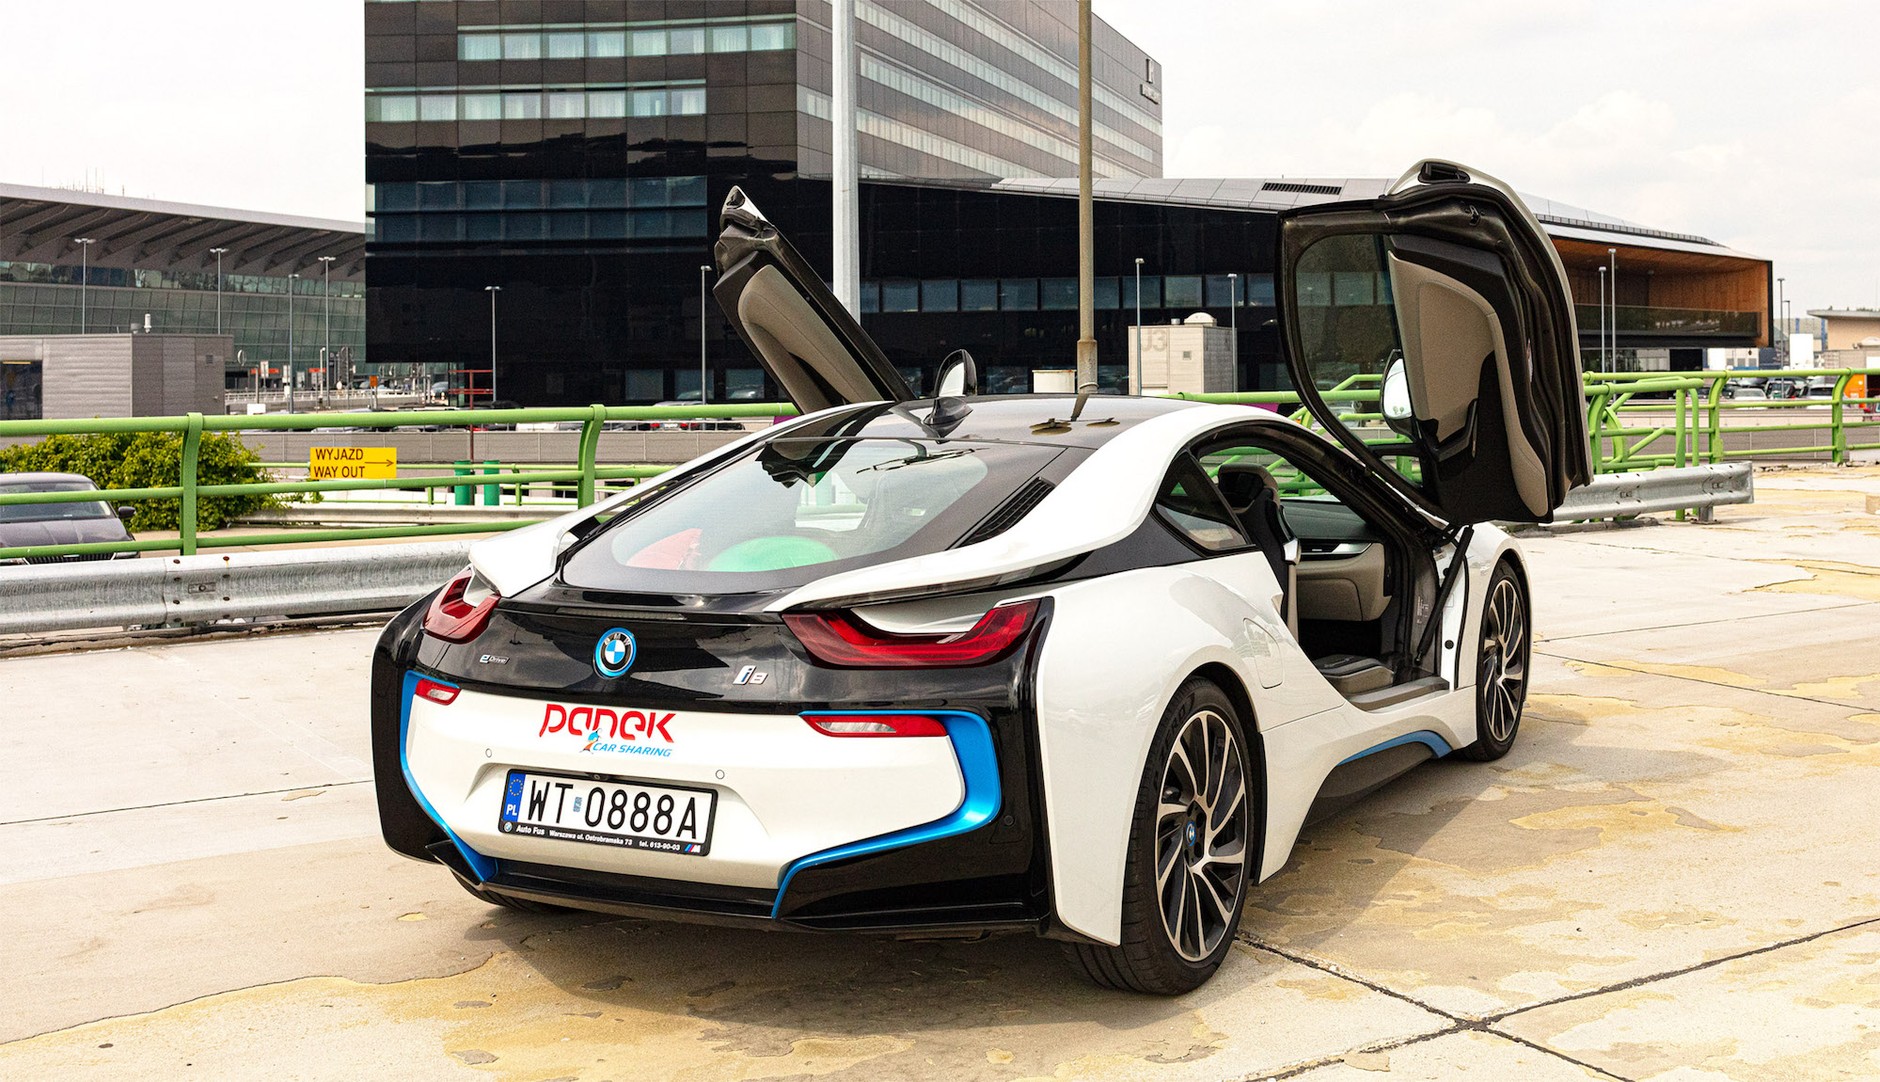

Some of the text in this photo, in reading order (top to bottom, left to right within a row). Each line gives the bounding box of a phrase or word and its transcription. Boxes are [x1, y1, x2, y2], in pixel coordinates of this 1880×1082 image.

[315, 448, 364, 461] WYJAZD
[314, 466, 366, 478] WAY OUT
[592, 742, 673, 758] CAR SHARING
[506, 804, 518, 816] PL
[527, 779, 697, 840] WT 0888A
[515, 824, 532, 834] Auto
[532, 826, 545, 836] Fus
[549, 829, 576, 839] Warszawa
[624, 838, 633, 846] 73
